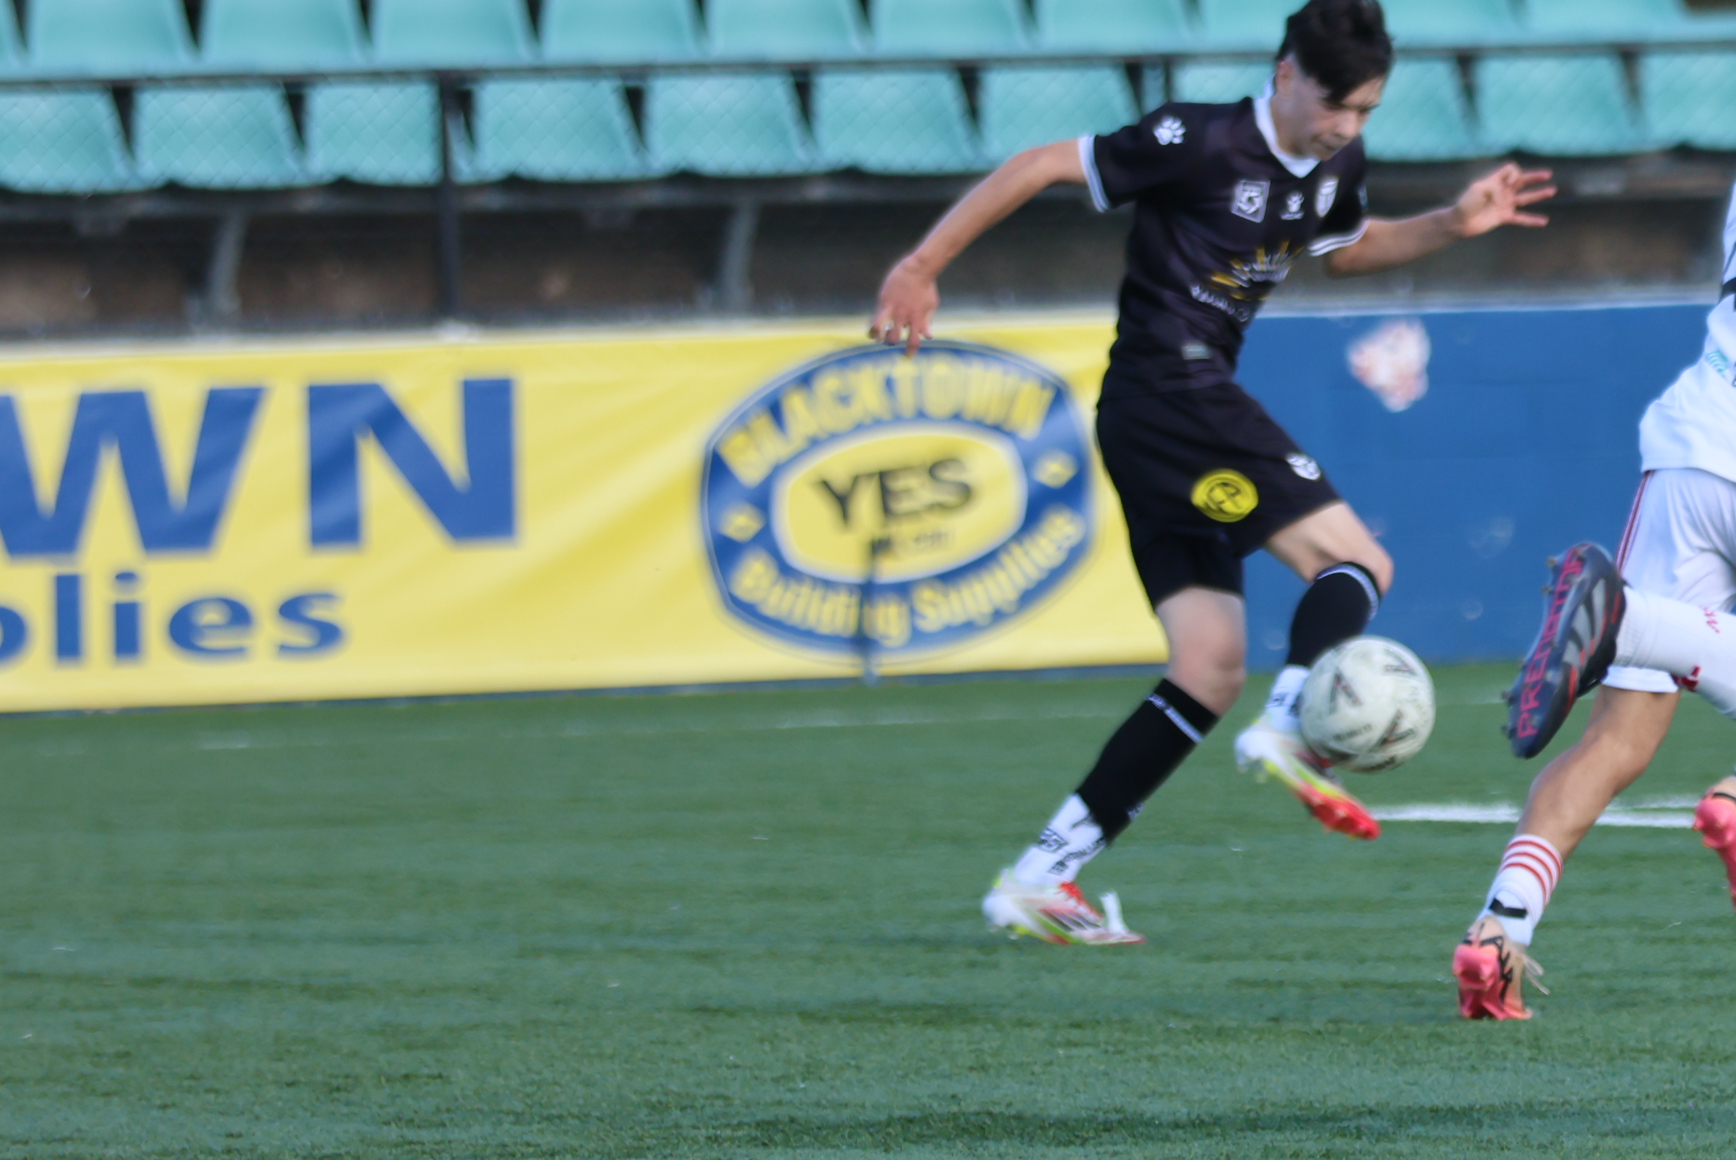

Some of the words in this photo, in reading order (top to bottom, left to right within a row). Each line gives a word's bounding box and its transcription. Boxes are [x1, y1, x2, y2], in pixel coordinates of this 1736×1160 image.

[715, 351, 1058, 488] BLACKTOWN
[816, 456, 976, 532] YES
[729, 548, 912, 649] Building
[912, 508, 1088, 633] Supplies
